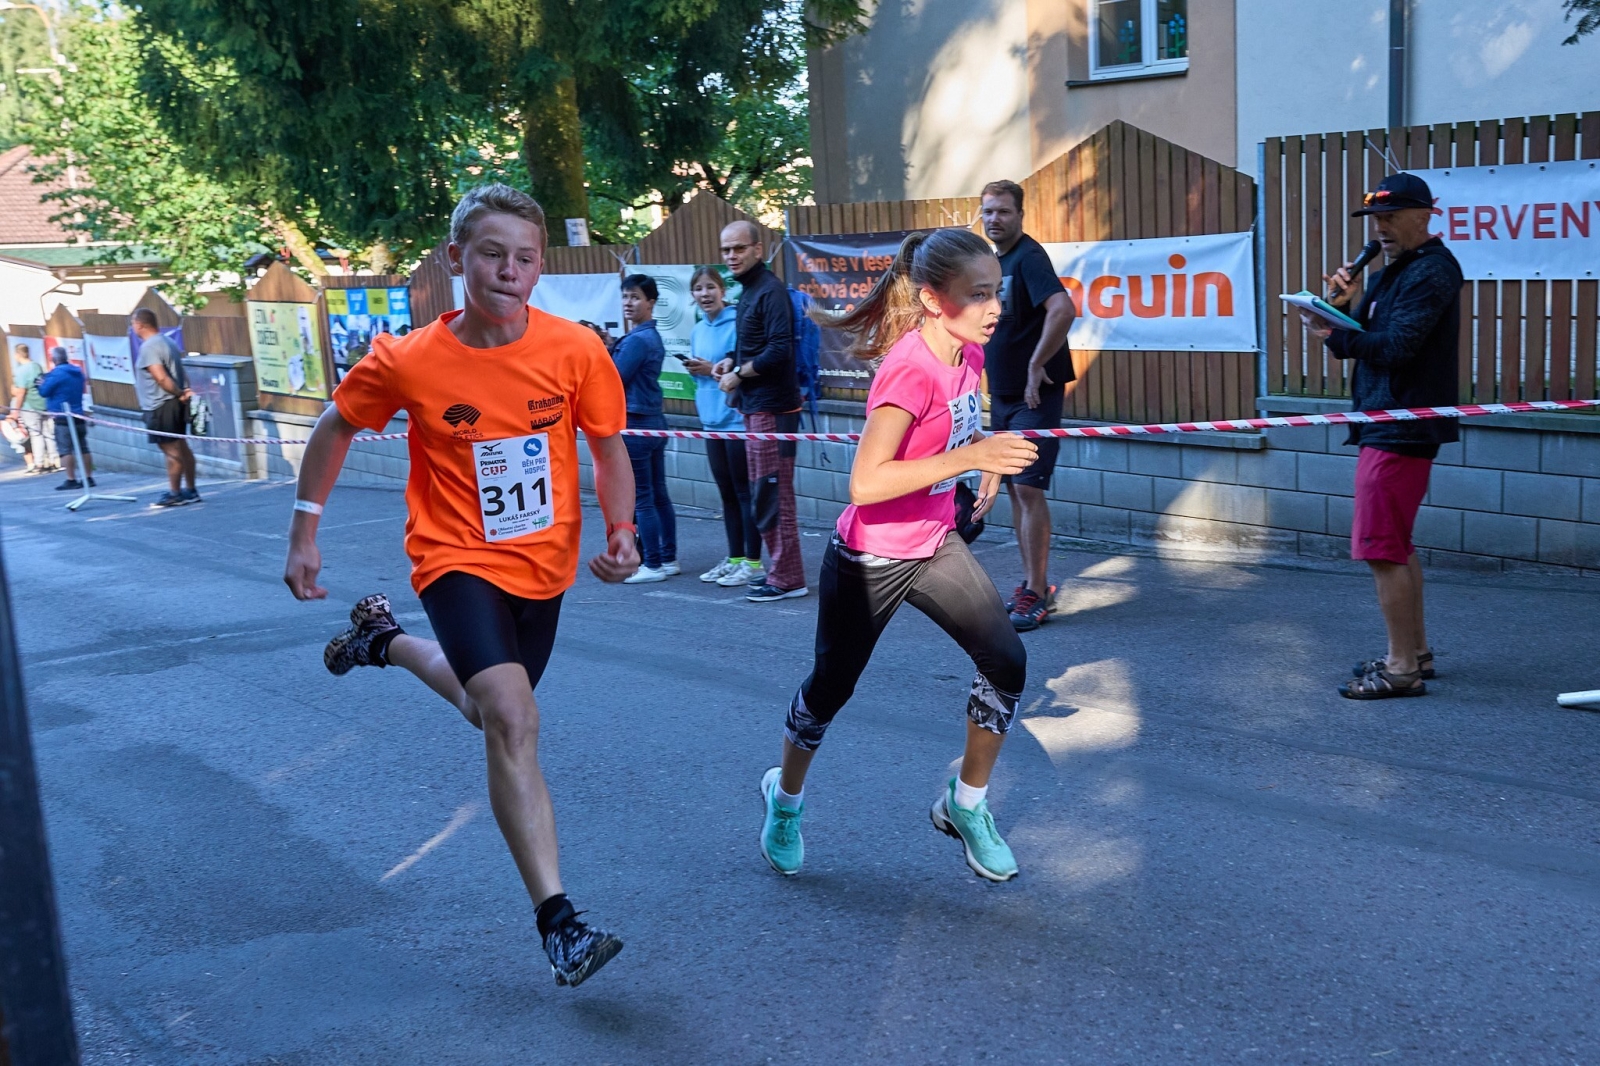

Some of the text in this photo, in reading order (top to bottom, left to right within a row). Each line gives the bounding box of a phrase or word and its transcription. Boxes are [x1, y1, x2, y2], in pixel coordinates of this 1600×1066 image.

[1428, 197, 1600, 241] ČERVEN
[796, 249, 894, 273] Kam se v lese
[798, 277, 848, 299] schová
[452, 428, 477, 436] WORLD
[522, 457, 547, 468] BĚH PRO
[524, 464, 546, 475] HOSPIC
[481, 465, 508, 477] CUP
[481, 477, 547, 517] 311
[498, 513, 519, 523] LUKÁŠ
[519, 508, 541, 519] FARSKÝ
